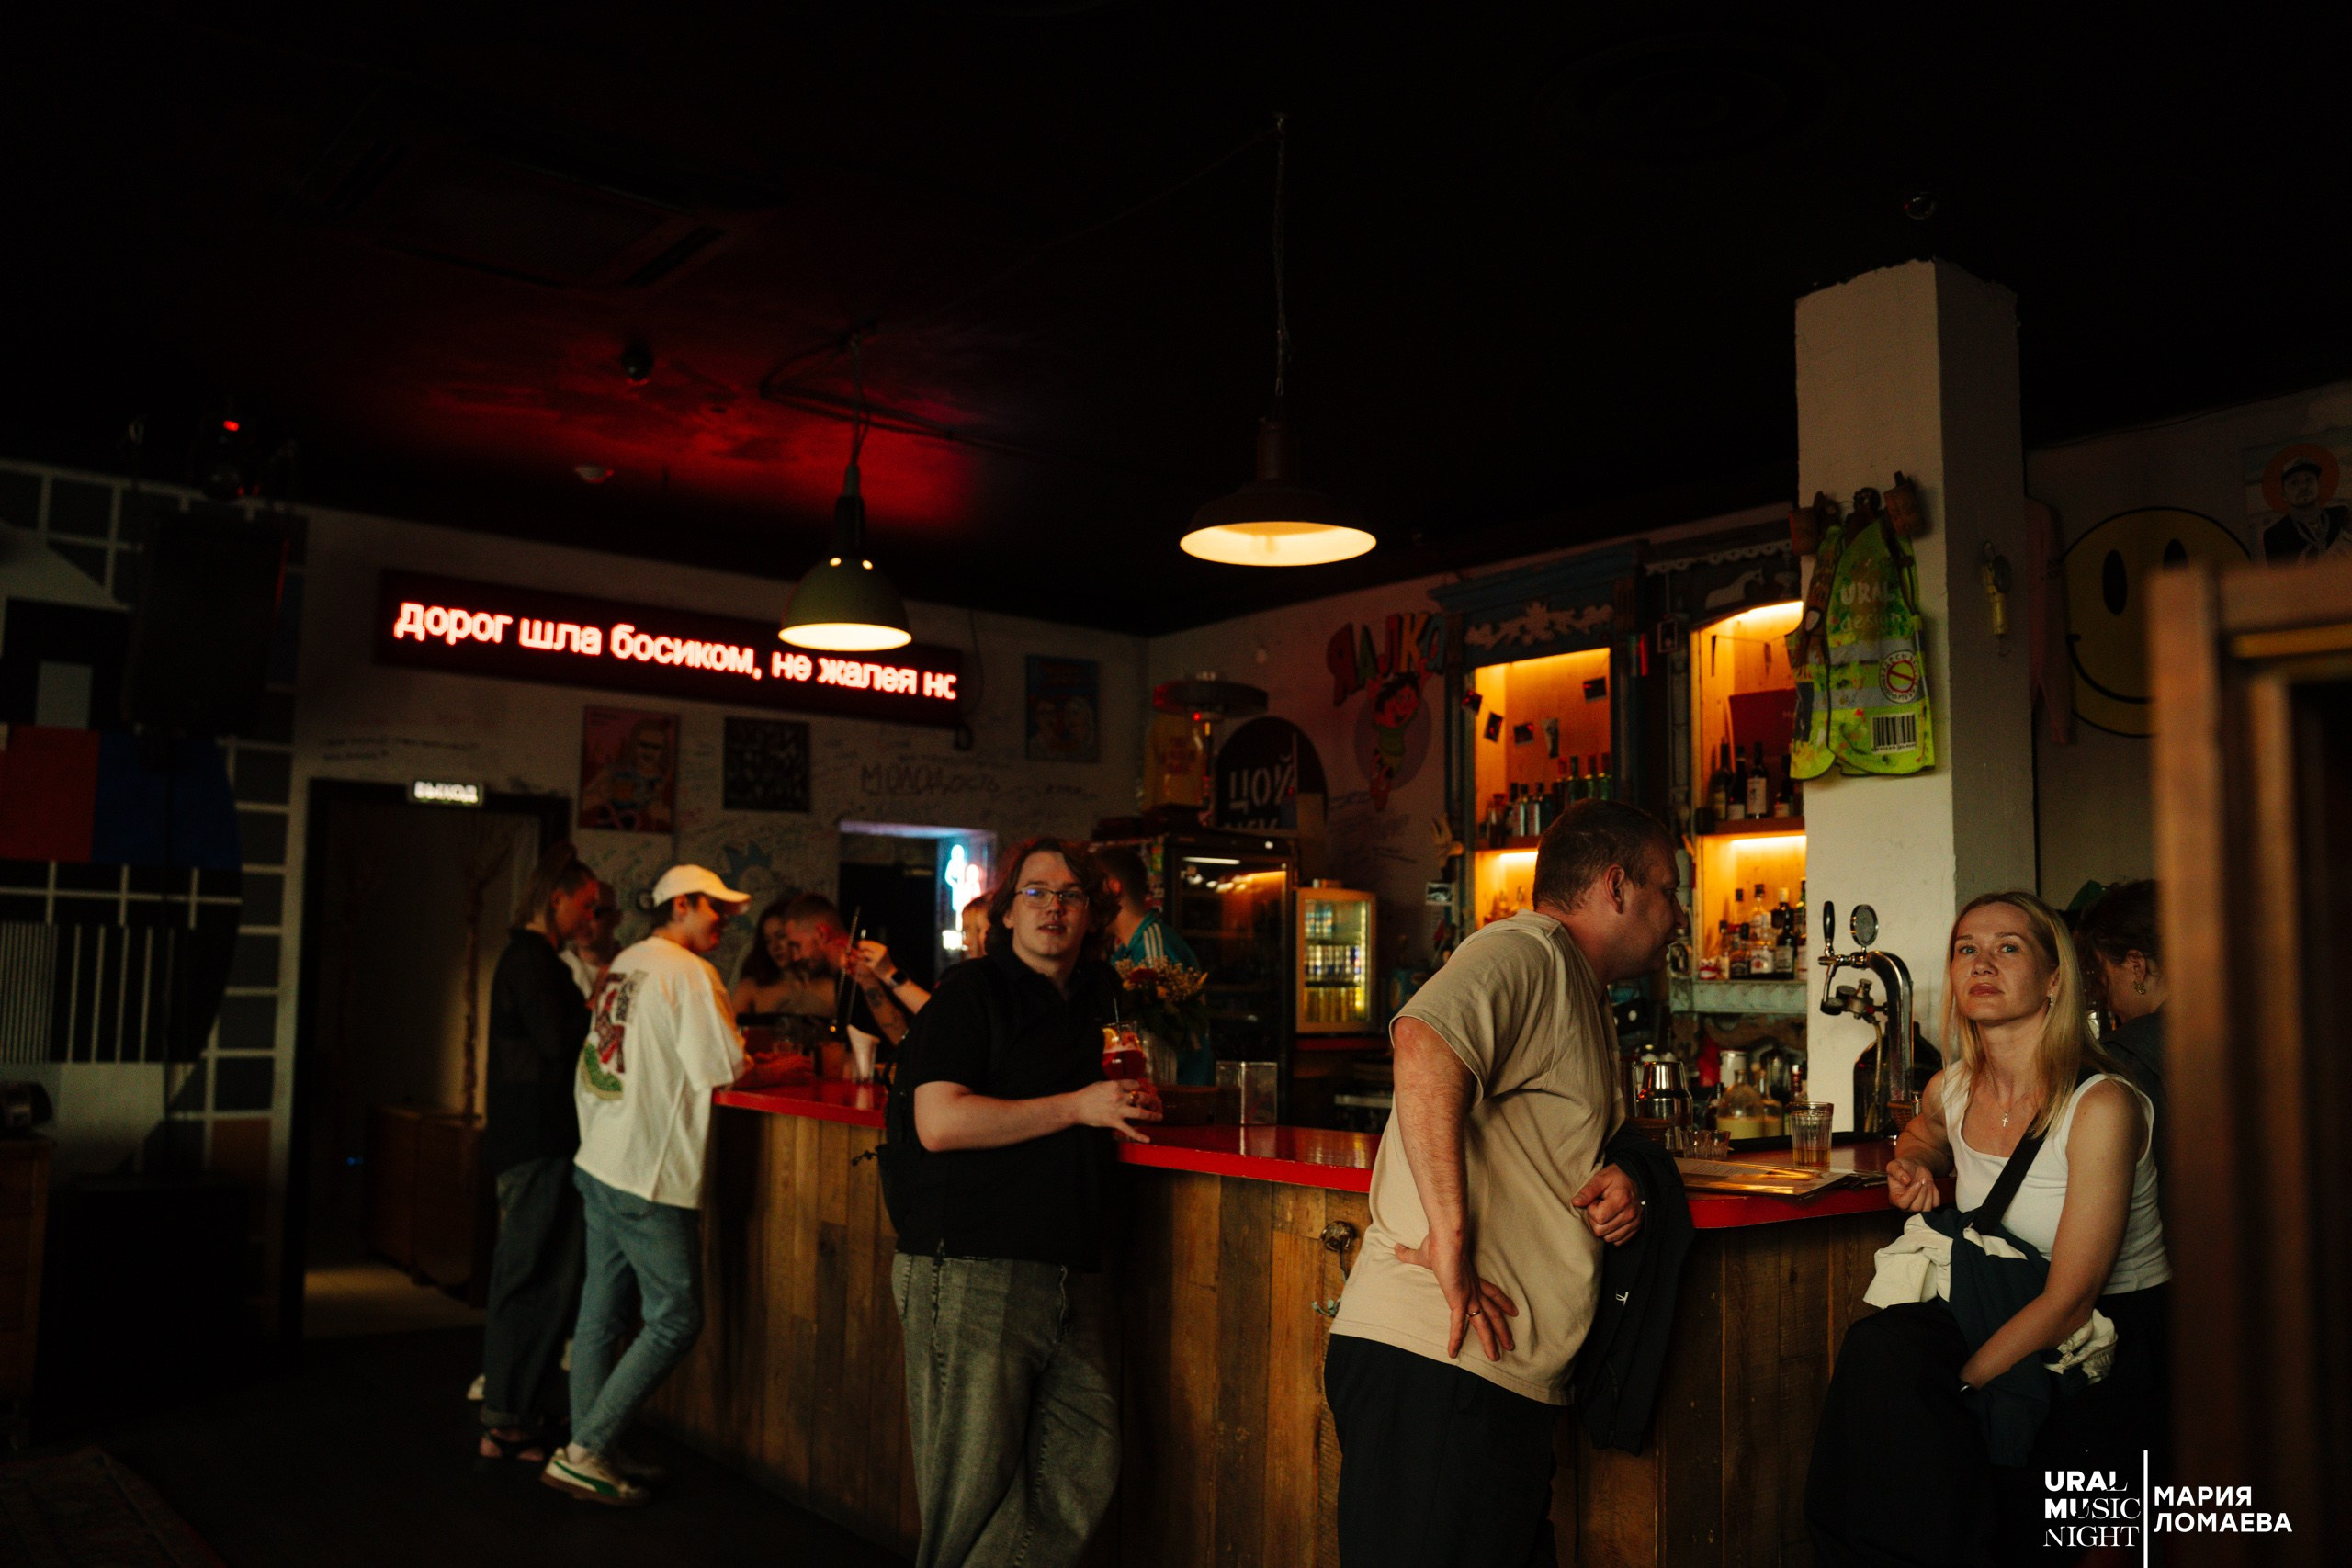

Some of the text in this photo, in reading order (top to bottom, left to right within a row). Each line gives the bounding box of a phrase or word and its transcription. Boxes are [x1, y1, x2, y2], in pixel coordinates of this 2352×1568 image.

[393, 602, 514, 646] дорог
[518, 617, 603, 656] шла
[610, 623, 763, 681] босиком,
[771, 650, 813, 682] не
[817, 657, 918, 695] жалея
